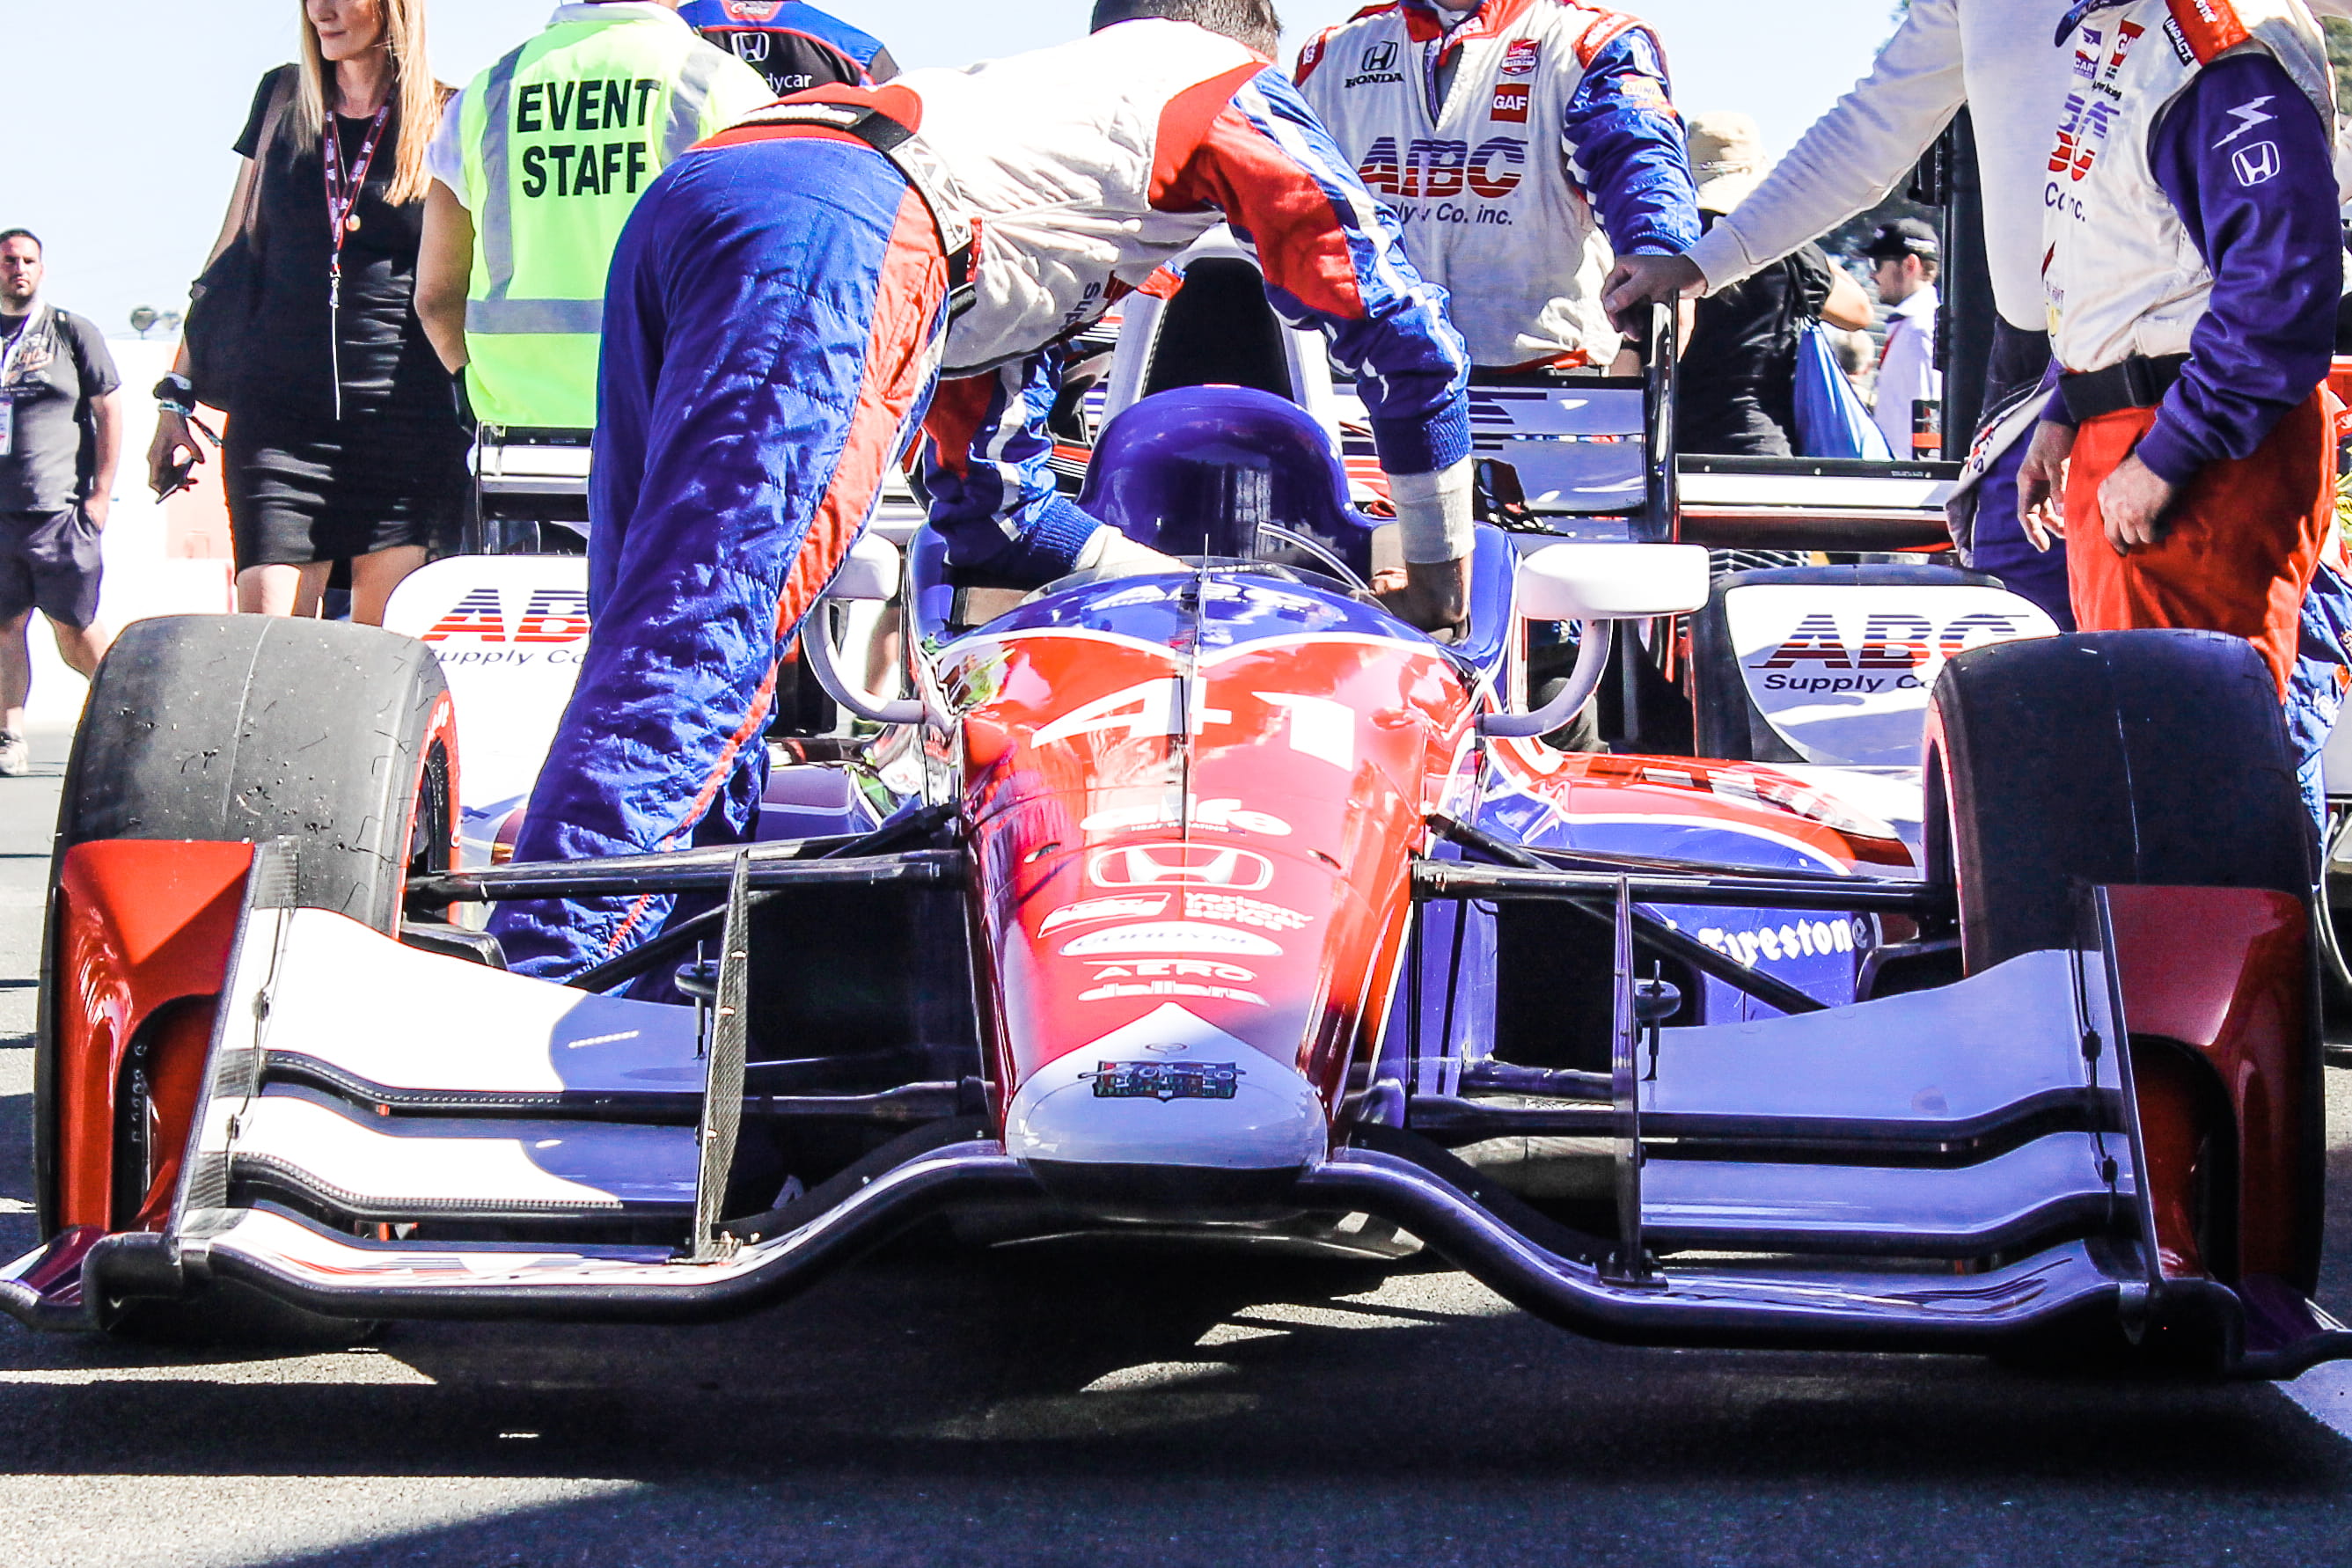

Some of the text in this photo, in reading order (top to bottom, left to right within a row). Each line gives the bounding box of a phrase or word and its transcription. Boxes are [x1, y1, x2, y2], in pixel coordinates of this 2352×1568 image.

[517, 78, 661, 133] EVENT
[1345, 72, 1405, 88] HONDA
[1492, 94, 1528, 111] GAF
[522, 141, 647, 198] STAFF
[1358, 136, 1528, 198] ABC
[1436, 202, 1469, 223] Co.
[1748, 613, 2030, 670] ABC
[1763, 673, 1885, 693] Supply
[1030, 676, 1355, 772] 41
[1698, 918, 1867, 969] Firestone
[1093, 963, 1254, 981] AERO
